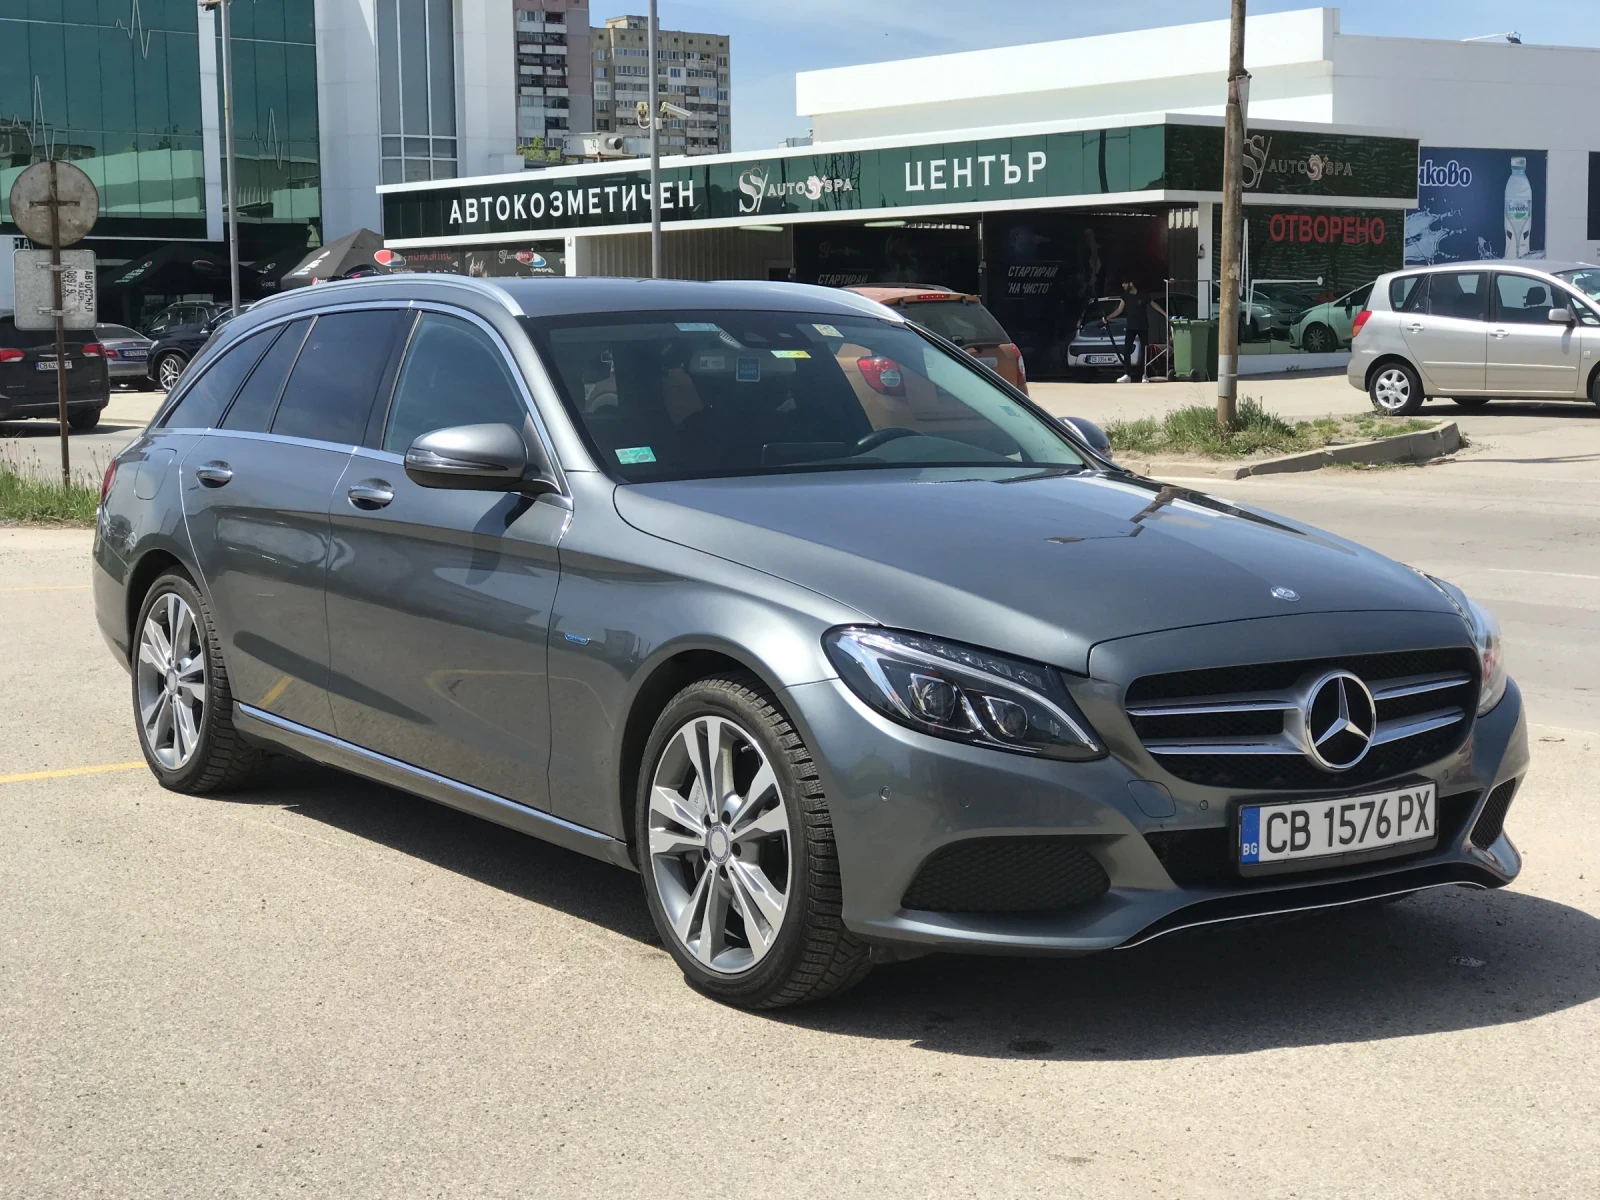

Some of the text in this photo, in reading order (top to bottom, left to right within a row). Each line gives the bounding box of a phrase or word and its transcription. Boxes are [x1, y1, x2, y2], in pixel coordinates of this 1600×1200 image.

[905, 151, 1047, 191] ЦЕНТЪР
[1268, 159, 1307, 173] AUTO
[1325, 162, 1353, 176] SPA
[767, 182, 806, 196] AUTO
[824, 178, 853, 193] SPA
[449, 180, 694, 224] АВТОКОЗМЕТИЧЕН
[1269, 213, 1386, 244] ОТВОРЕНО
[818, 273, 868, 285] СТАРТИРАЙ
[1008, 265, 1059, 278] СТАРТИРАЙ
[1266, 791, 1430, 854] CB 1576 PX
[1242, 843, 1257, 855] BG
